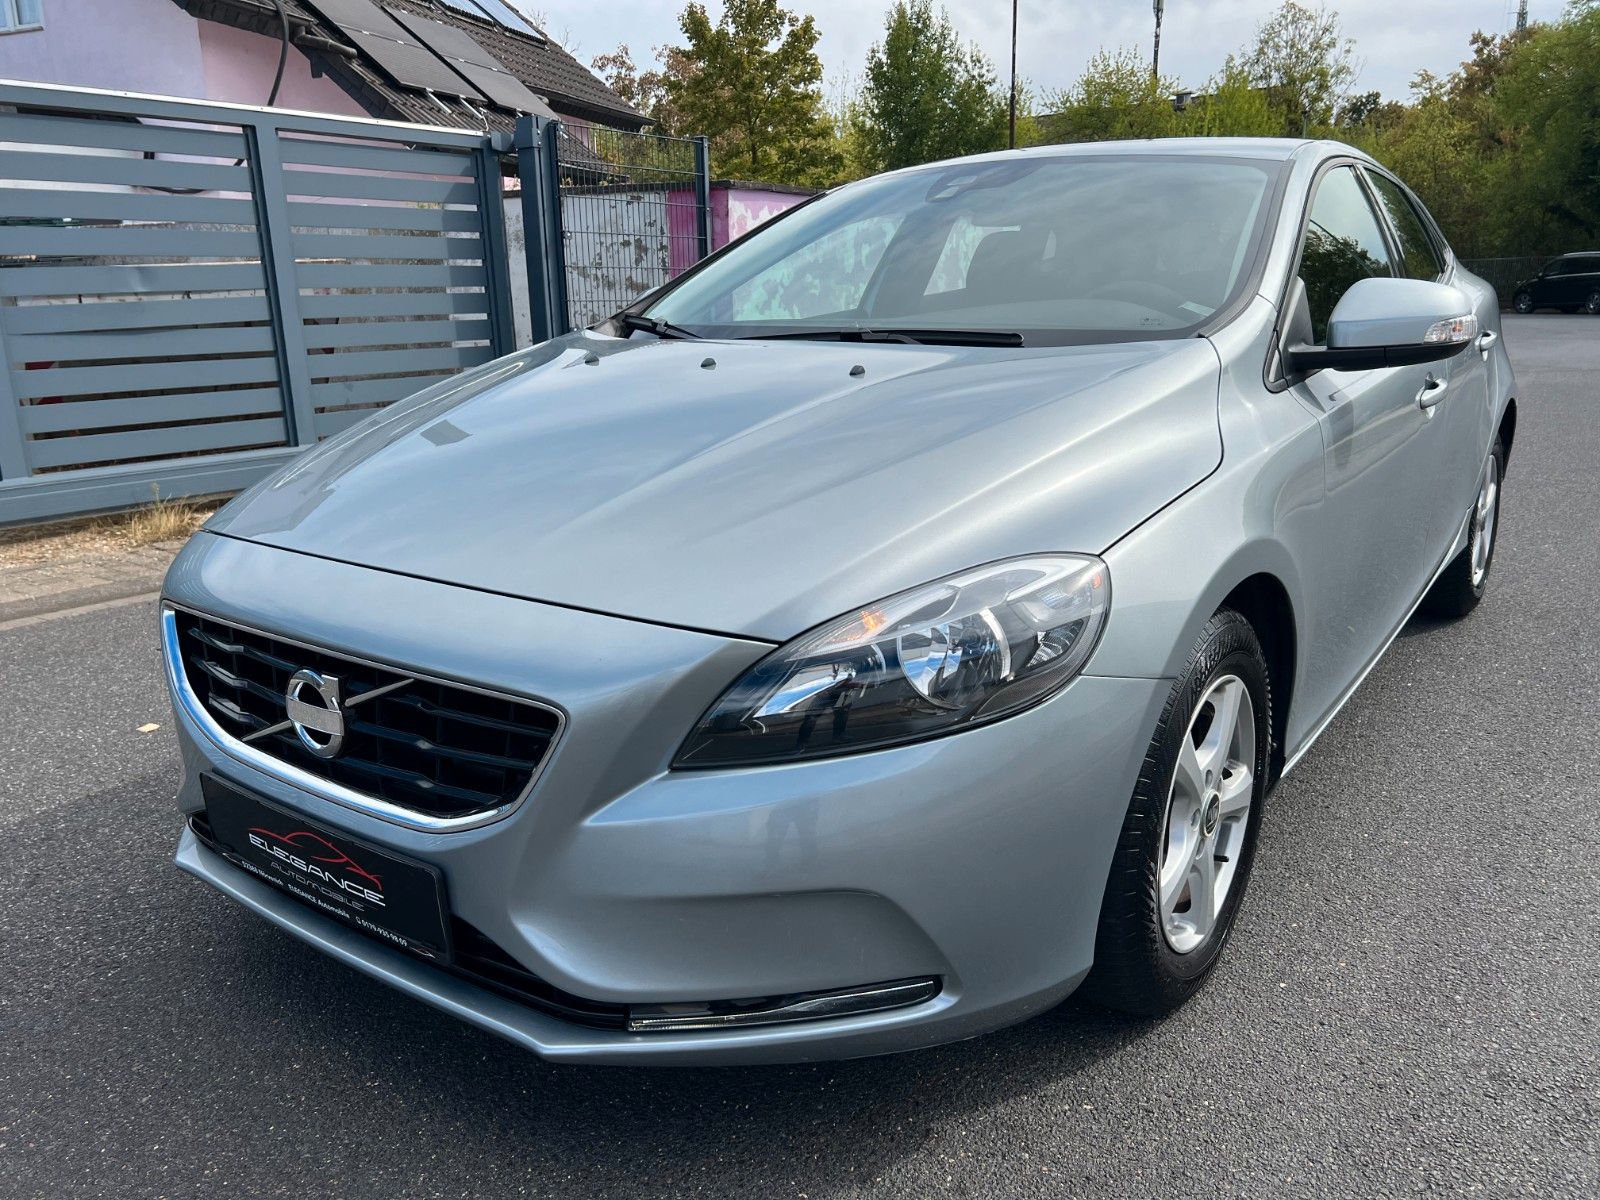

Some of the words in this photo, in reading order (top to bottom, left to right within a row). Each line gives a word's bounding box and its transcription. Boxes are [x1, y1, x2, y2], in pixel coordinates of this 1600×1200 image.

[248, 833, 386, 907] ELEGANCE
[270, 861, 365, 911] AUTOMOBILE
[288, 884, 317, 903] ELEGANCE
[317, 899, 351, 918] Automobile
